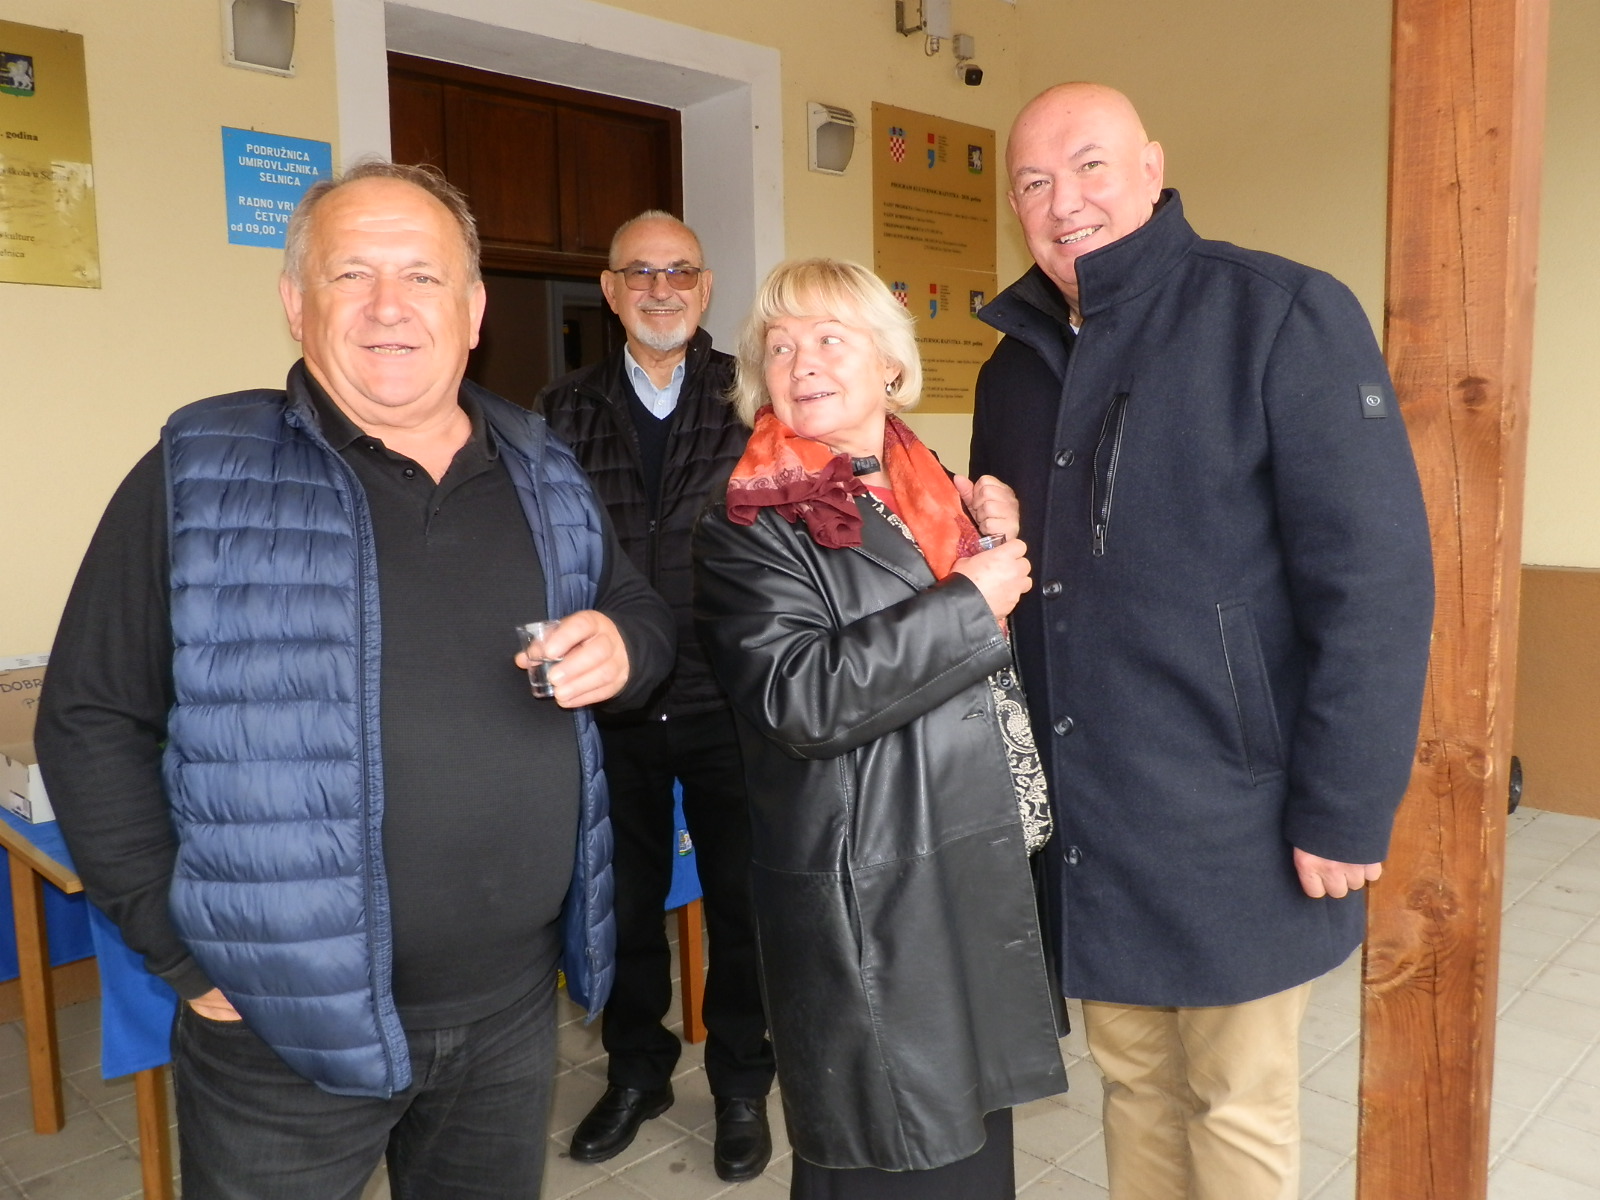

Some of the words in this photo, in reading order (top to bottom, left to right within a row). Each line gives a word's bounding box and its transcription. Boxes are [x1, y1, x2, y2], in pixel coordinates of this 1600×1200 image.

[5, 131, 39, 141] godina
[246, 143, 310, 162] PODRUŽNICA
[238, 156, 319, 175] UMIROVLJENIKA
[259, 172, 301, 186] SELNICA
[238, 195, 274, 209] RADNO
[277, 200, 295, 211] VRI
[230, 223, 243, 232] od
[0, 249, 25, 258] elnica
[0, 678, 43, 693] DOBR
